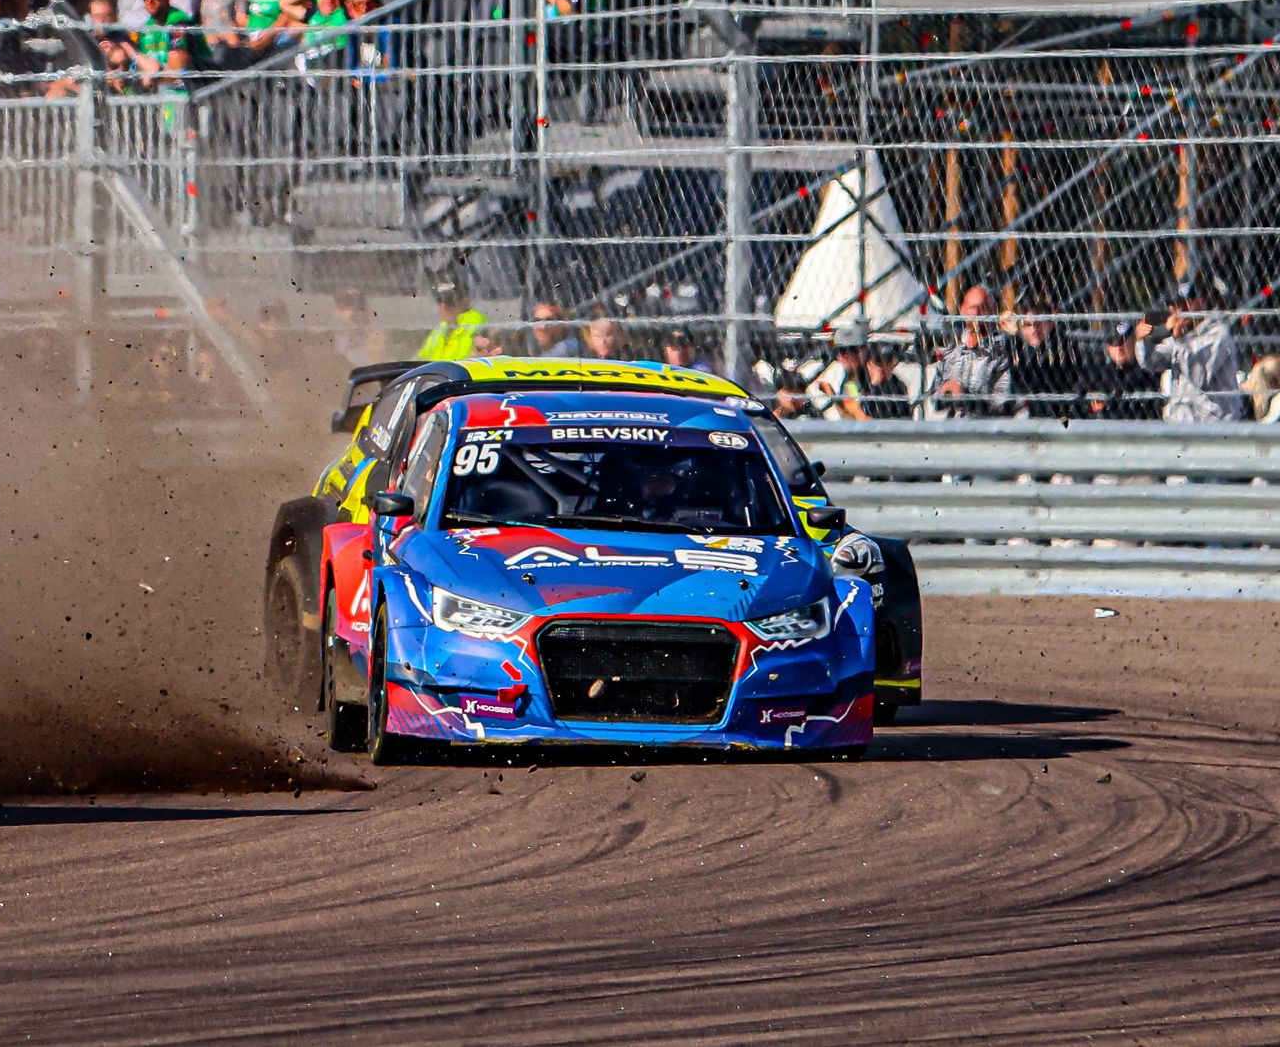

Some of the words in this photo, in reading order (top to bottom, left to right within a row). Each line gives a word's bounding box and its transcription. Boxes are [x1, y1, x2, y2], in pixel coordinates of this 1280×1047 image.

[504, 369, 709, 386] MARTIN
[552, 427, 669, 442] BELEVSKIY
[712, 434, 746, 448] FIA
[453, 443, 502, 477] 95
[477, 704, 514, 714] HOOSIER
